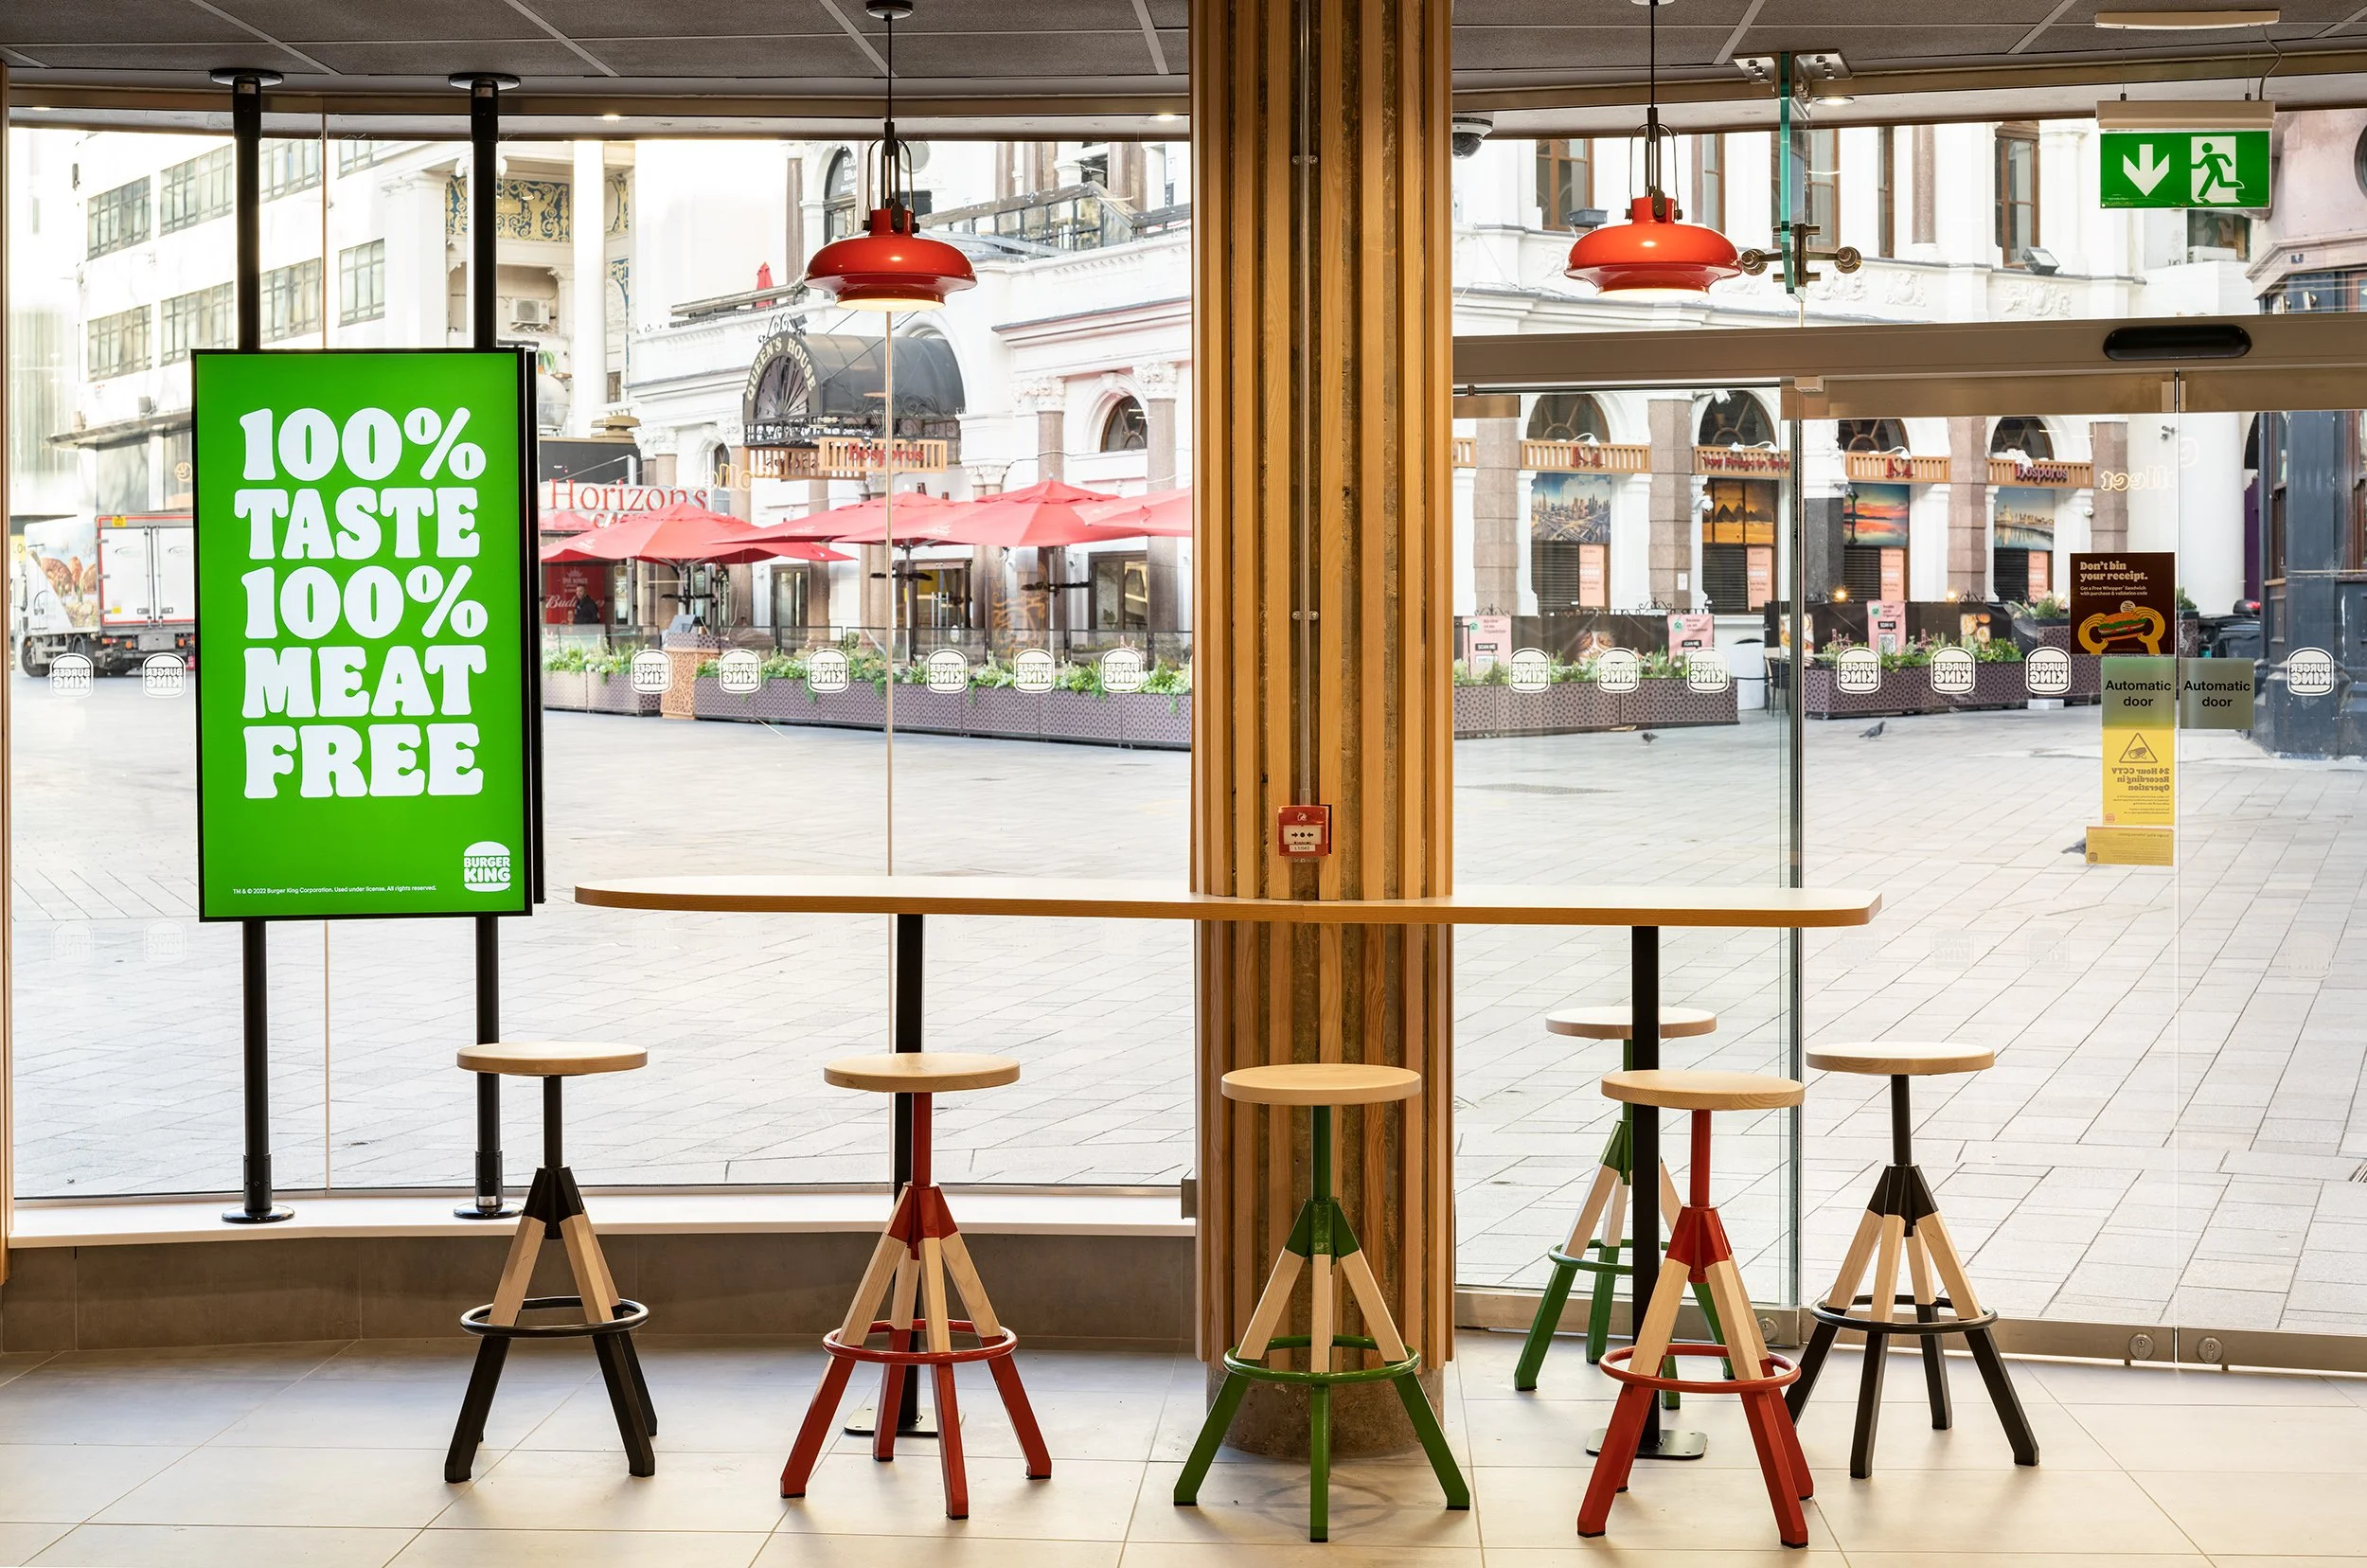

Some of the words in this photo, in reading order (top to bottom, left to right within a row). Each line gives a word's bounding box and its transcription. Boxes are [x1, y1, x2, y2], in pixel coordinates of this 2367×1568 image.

[747, 337, 782, 401] QUEEN'S
[787, 338, 816, 391] HOUSE
[239, 407, 486, 481] 100%
[549, 478, 707, 511] Horizons
[234, 486, 480, 560] TASTE
[2080, 561, 2108, 570] Don't
[2109, 561, 2127, 570] bin
[2080, 572, 2106, 582] your
[2107, 570, 2148, 582] receipt.
[241, 565, 488, 639] 100%
[242, 645, 487, 719] MEAT
[2105, 680, 2172, 691] Automatic
[2184, 680, 2251, 691] Automatic
[2123, 696, 2153, 707] door
[2202, 697, 2233, 707] door
[243, 723, 483, 799] FREE
[464, 856, 510, 868] BURGER
[464, 867, 511, 882] KING
